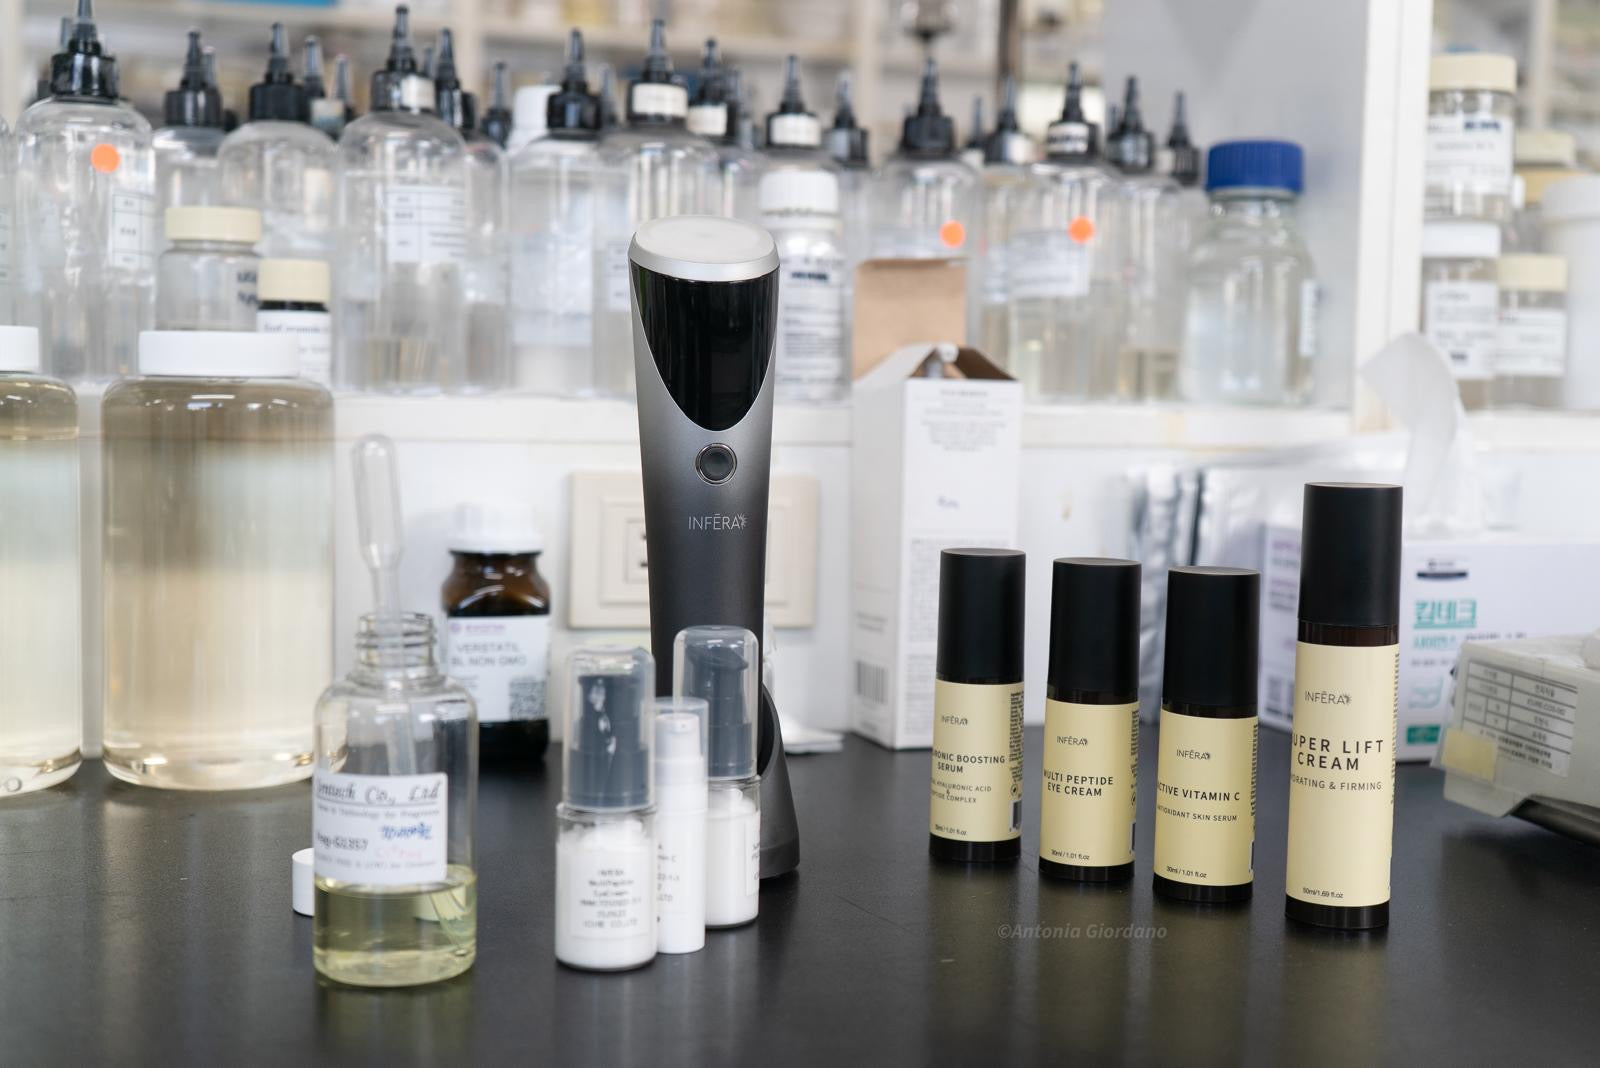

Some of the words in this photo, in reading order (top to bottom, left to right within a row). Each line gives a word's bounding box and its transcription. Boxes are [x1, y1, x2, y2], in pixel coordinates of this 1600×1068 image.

[1342, 739, 1384, 754] LIFT
[956, 754, 1006, 765] BOOSTING
[1297, 751, 1359, 771] CREAM
[937, 761, 964, 773] SERUM
[1066, 774, 1114, 786] PEPTIDE
[1329, 781, 1336, 790] &
[1340, 781, 1382, 791] FIRMING
[1047, 781, 1061, 793] EYE
[1064, 785, 1102, 797] CREAM
[1157, 780, 1179, 796] CTIVE
[1182, 788, 1230, 801] VITAMIN
[1234, 792, 1240, 801] C
[1193, 813, 1210, 821] SKIN
[1213, 814, 1237, 822] SERUM
